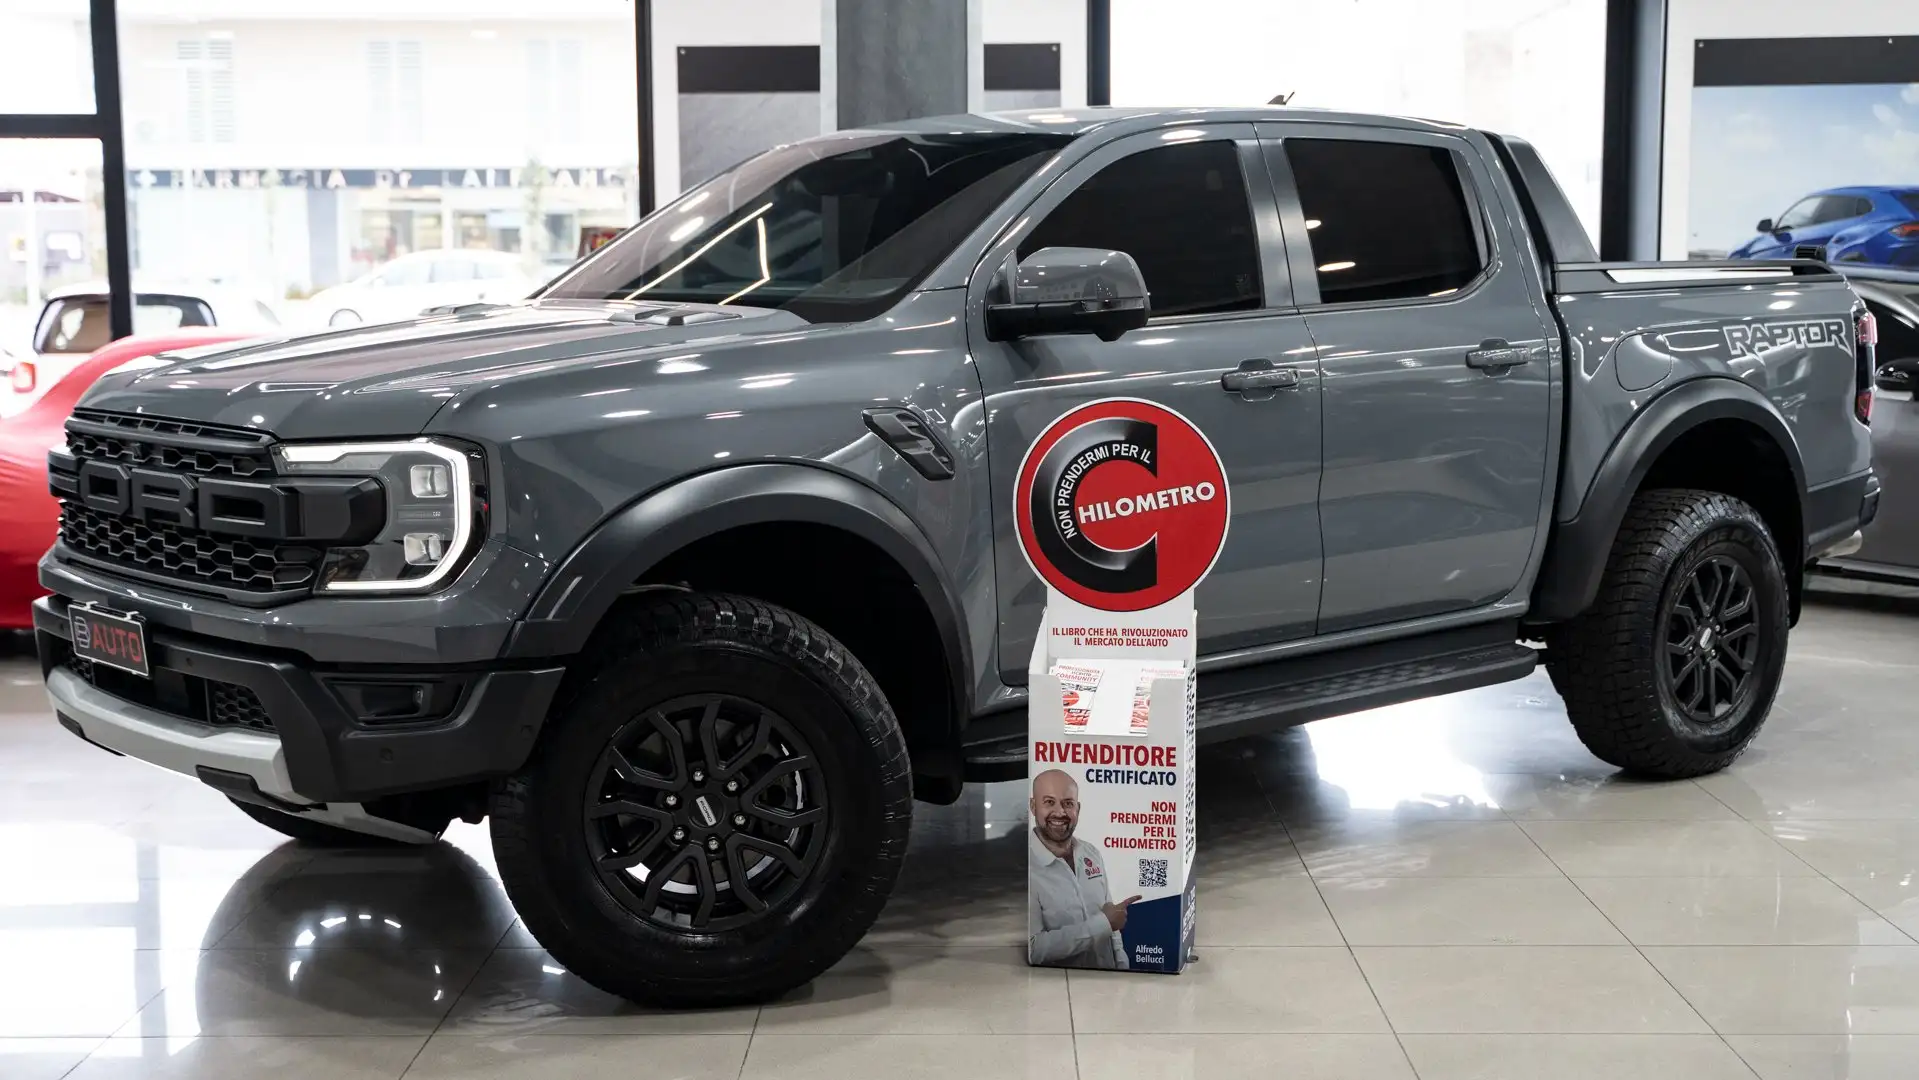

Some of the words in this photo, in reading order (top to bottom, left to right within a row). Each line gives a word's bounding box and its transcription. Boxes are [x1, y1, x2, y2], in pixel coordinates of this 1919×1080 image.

[1723, 319, 1853, 366] RAPTOR
[1112, 443, 1139, 459] PER
[1140, 448, 1152, 465] IL
[1057, 445, 1109, 507] PRENDERMI
[1058, 510, 1077, 539] NON
[1052, 628, 1060, 636] IL
[1061, 628, 1085, 636] LIBRO
[1088, 628, 1104, 636] CHE
[1106, 628, 1118, 636] HA
[1121, 628, 1188, 637] RIVOLUZIONATO
[93, 624, 143, 664] AUTO
[1074, 638, 1081, 646] IL
[1085, 638, 1124, 647] MERCATO
[1126, 638, 1169, 647] DELL'AUTO
[1034, 741, 1177, 768] RIVENDITORE
[1085, 768, 1177, 786] CERTIFICATO
[1151, 801, 1176, 813] NON
[1110, 812, 1176, 825] PRENDERMI
[1143, 826, 1165, 838] PER
[1167, 827, 1177, 838] IL
[1104, 837, 1177, 850] CHILOMETRO
[1135, 945, 1163, 954] Alfredo
[1135, 954, 1165, 964] Bellucci
